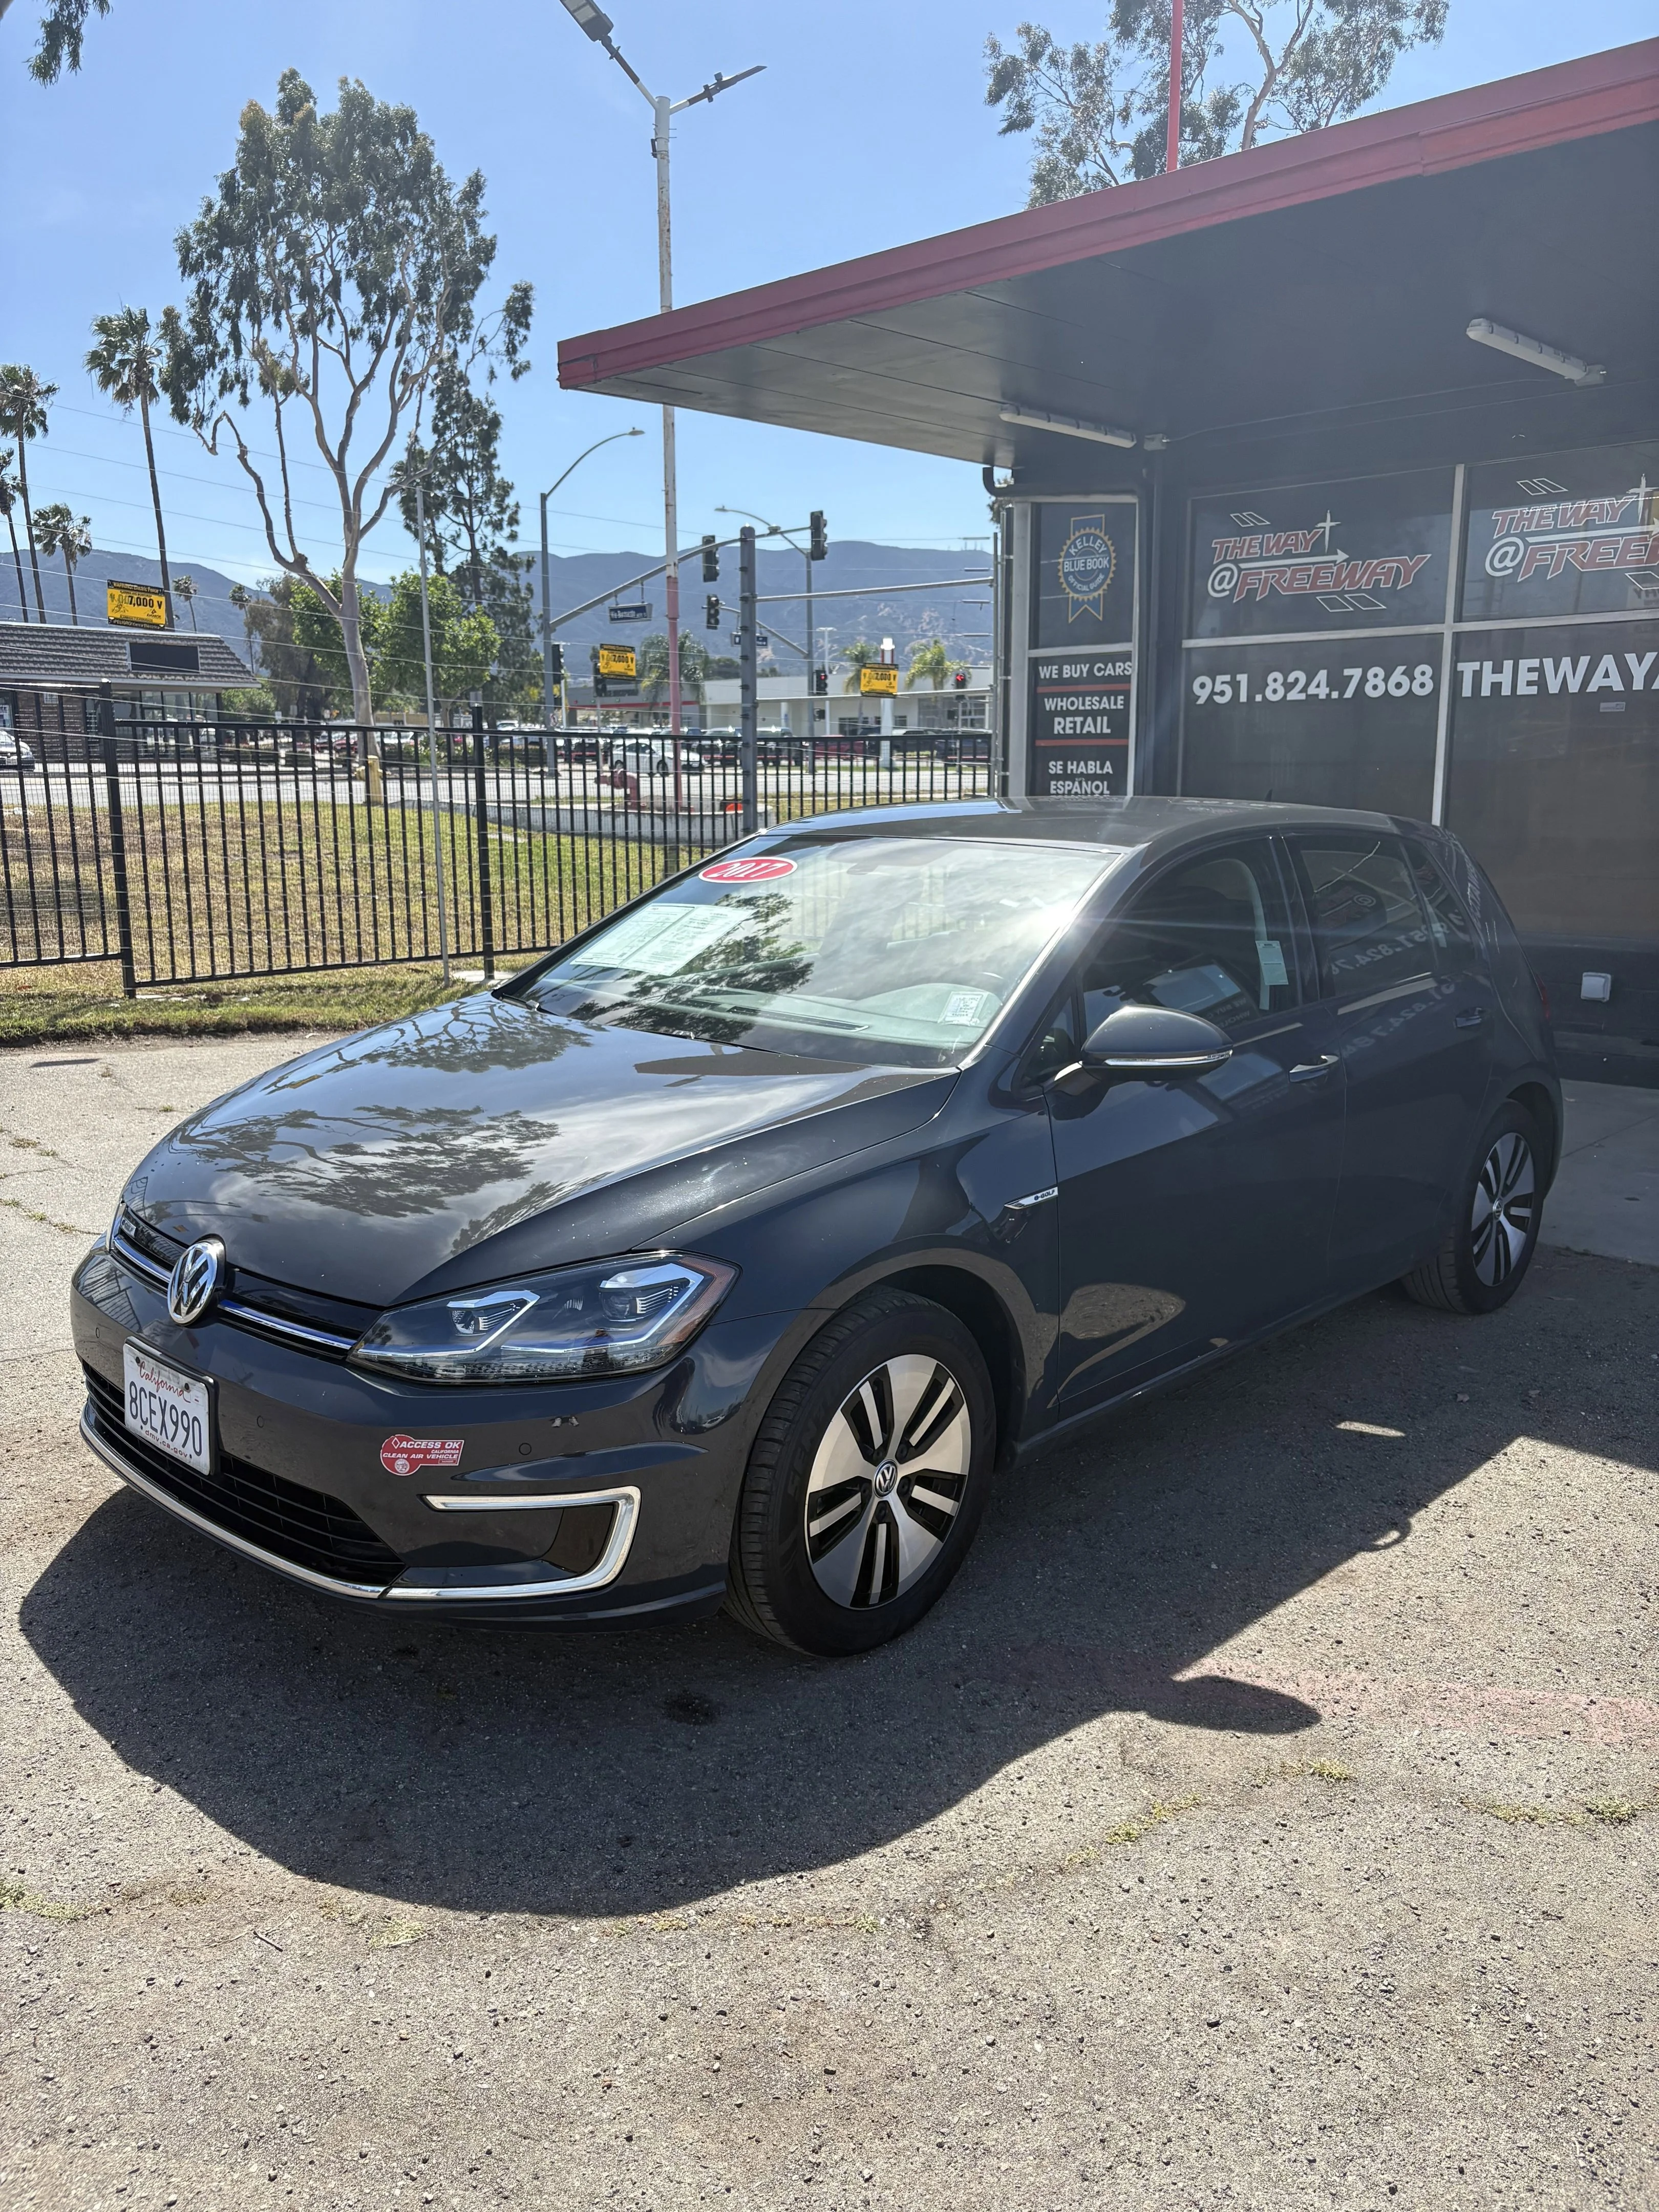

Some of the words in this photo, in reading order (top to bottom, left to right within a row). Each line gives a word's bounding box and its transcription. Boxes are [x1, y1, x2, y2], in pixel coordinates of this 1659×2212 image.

[1069, 536, 1107, 556] KELLEY
[1064, 559, 1085, 572] BLUE
[1087, 557, 1109, 570] BOOK
[1068, 575, 1090, 591] OFFICIAL
[1090, 573, 1104, 589] GUIDE
[129, 595, 154, 608] 7,000
[157, 601, 162, 609] V
[1038, 666, 1058, 679] WE
[1063, 664, 1090, 678] BUY
[1094, 662, 1132, 676] CARS
[1457, 651, 1659, 697] THEWAY
[1193, 664, 1434, 705] 951.824.7868
[1044, 696, 1124, 711] WHOLESALE
[1054, 716, 1111, 734] RETAIL
[1048, 760, 1063, 774] SE
[1067, 760, 1113, 774] HABLA
[1050, 778, 1110, 794] ESPAÑOL
[706, 862, 789, 878] 2017
[139, 1361, 191, 1403] California
[130, 1380, 202, 1457] 8CEX990
[145, 1430, 188, 1458] dmv.ca.gov
